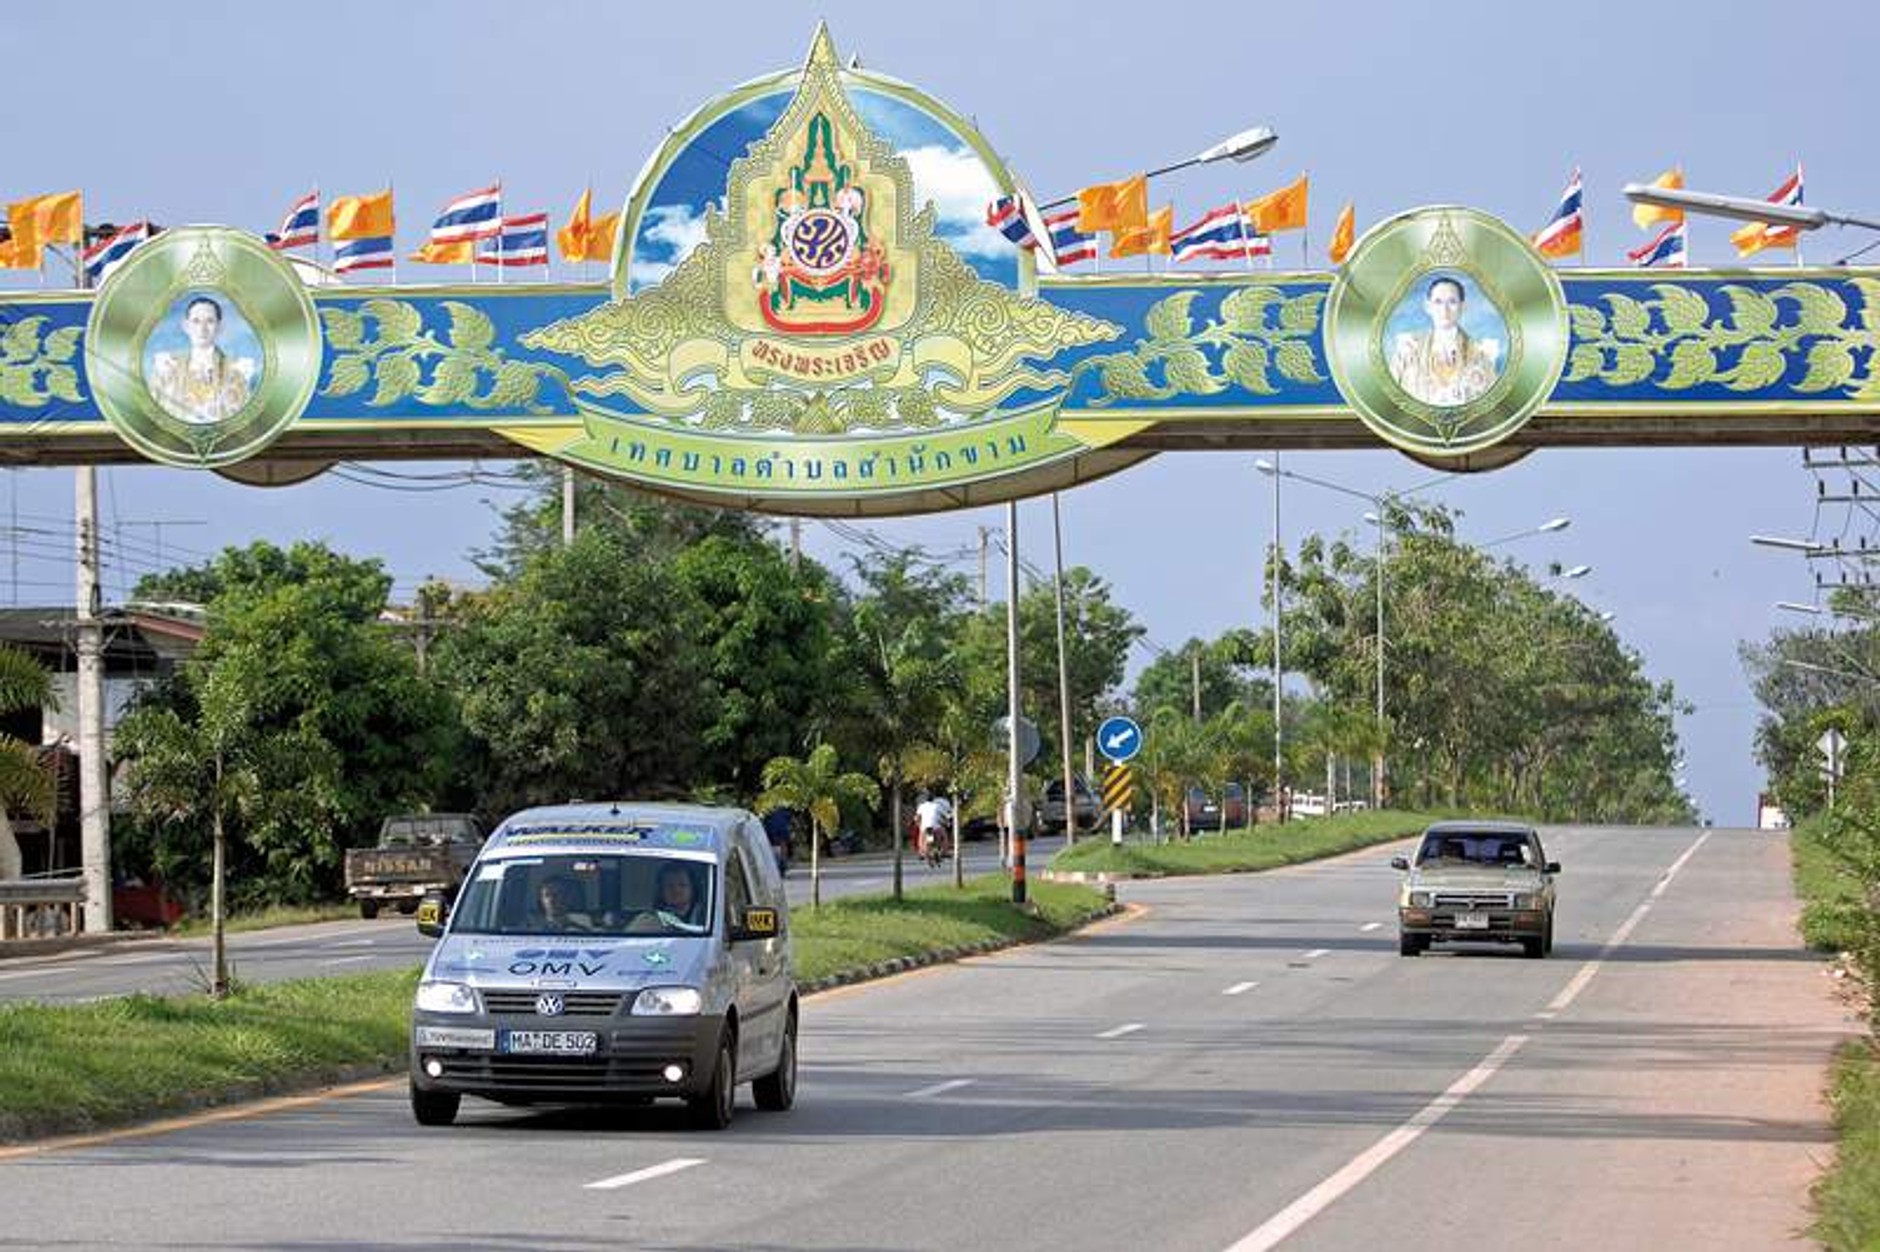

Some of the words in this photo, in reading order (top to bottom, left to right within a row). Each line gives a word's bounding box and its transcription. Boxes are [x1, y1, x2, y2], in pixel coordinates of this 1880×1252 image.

[752, 338, 891, 376] ทรงพระเจริญ
[611, 434, 1027, 480] เทศบาลตำบลสำนักขาม
[364, 858, 432, 874] NISSAN
[508, 962, 606, 977] OMV
[566, 1034, 597, 1050] 502
